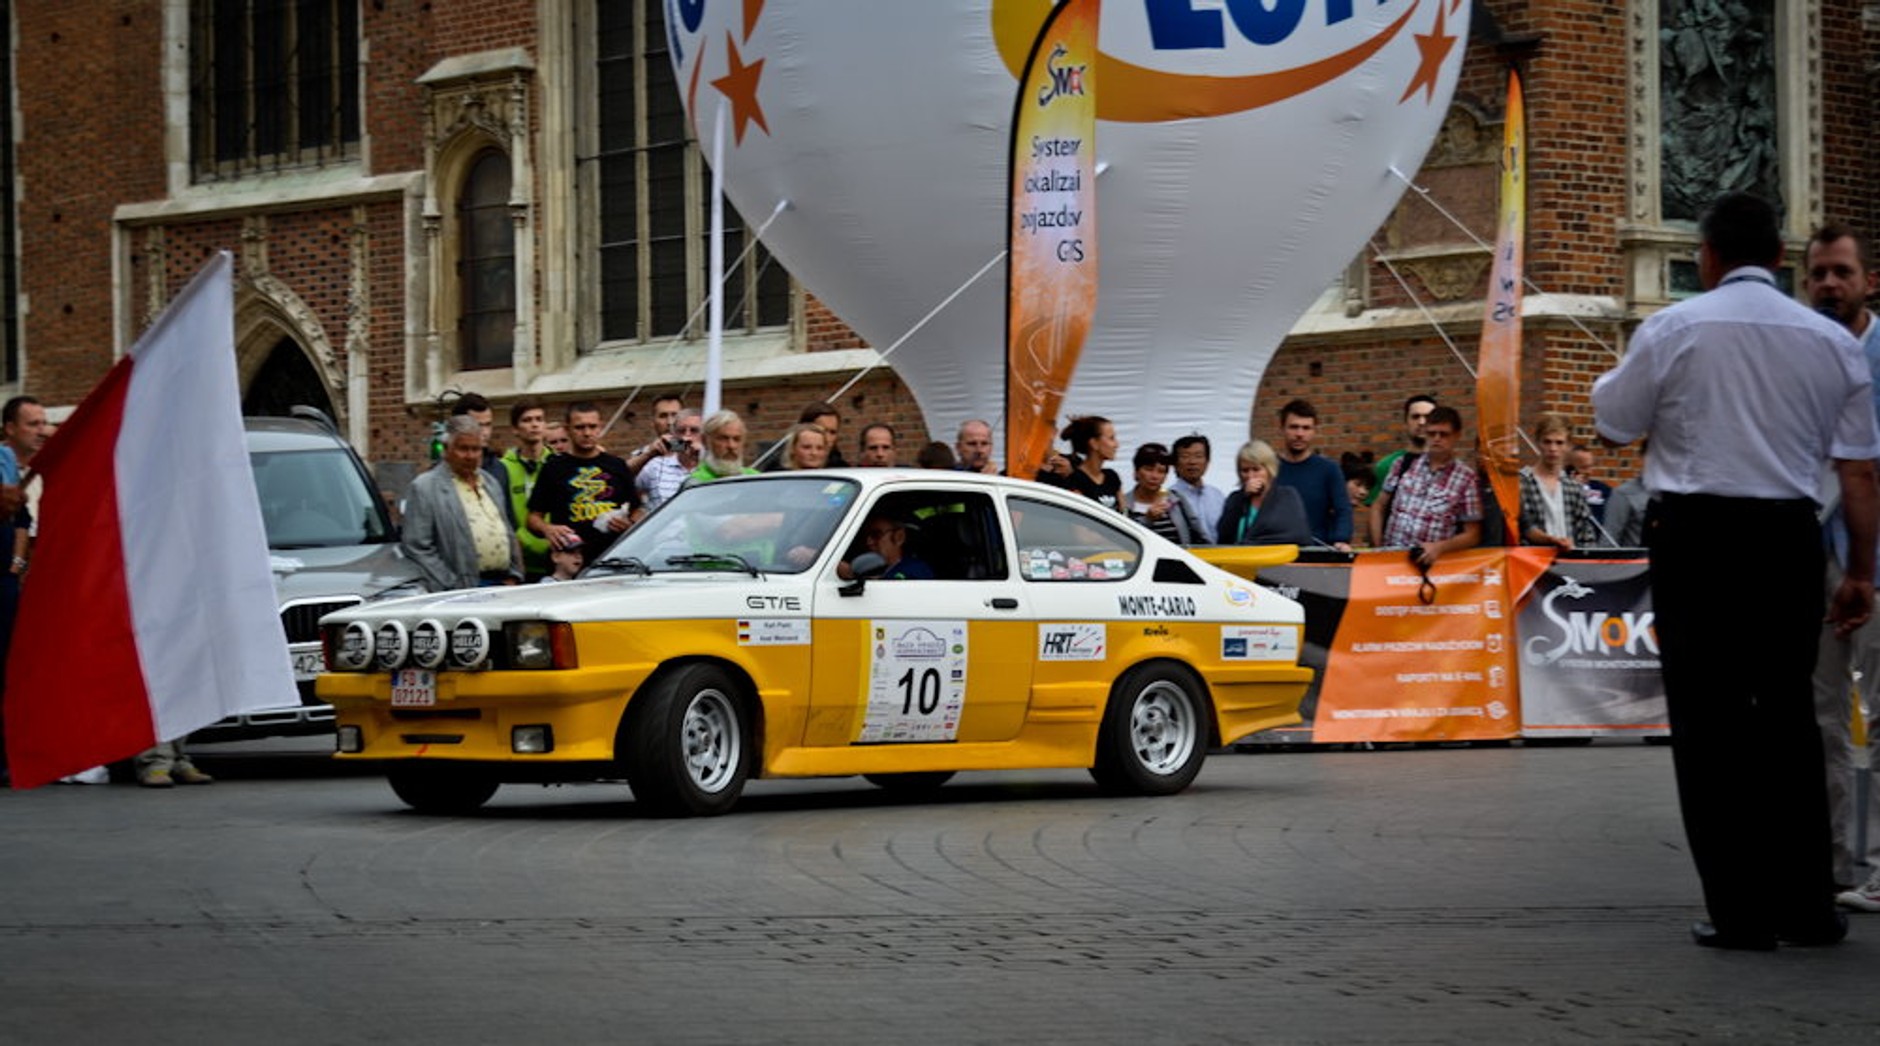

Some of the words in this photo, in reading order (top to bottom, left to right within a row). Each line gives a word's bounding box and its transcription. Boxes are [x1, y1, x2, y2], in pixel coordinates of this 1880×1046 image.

[1057, 239, 1084, 262] GS
[1117, 595, 1197, 617] MONTE-CARLO
[1525, 575, 1661, 666] SMOK
[453, 634, 483, 649] HELLA
[898, 667, 941, 715] 10
